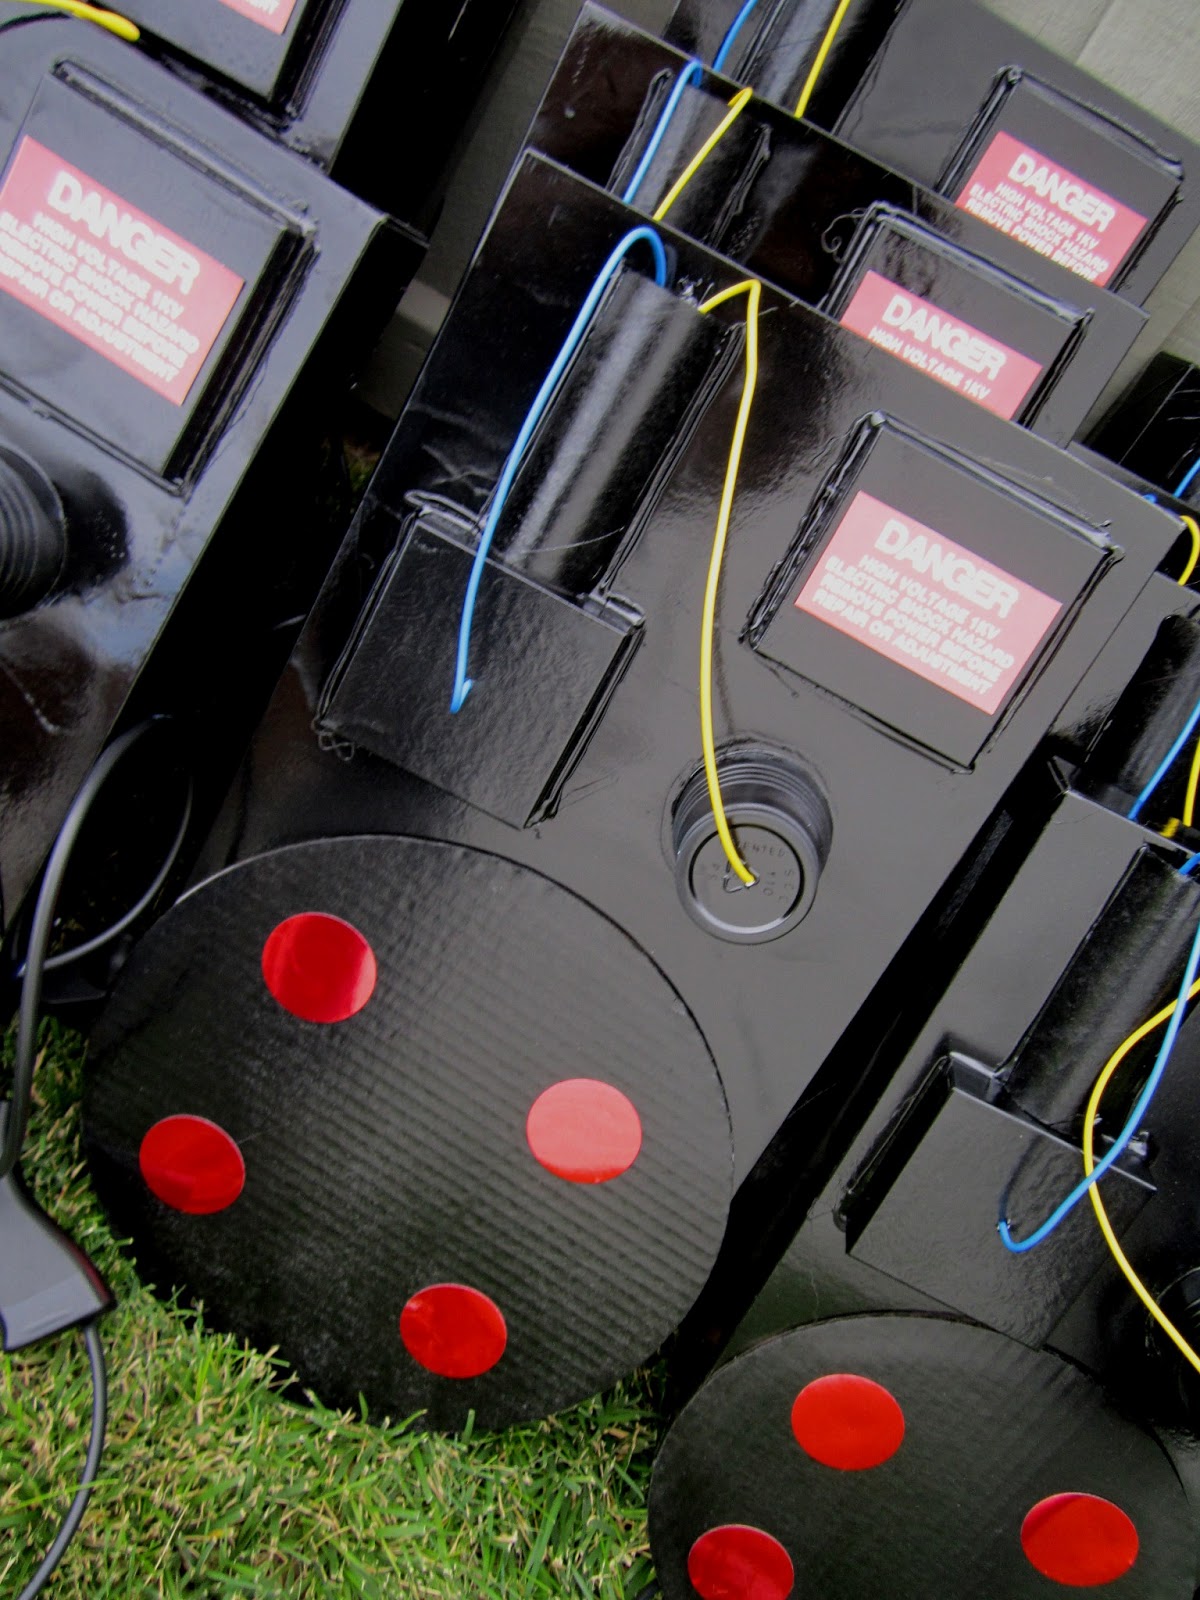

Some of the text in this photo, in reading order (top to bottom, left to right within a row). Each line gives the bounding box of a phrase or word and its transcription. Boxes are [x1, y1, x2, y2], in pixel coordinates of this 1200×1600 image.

[46, 169, 201, 297] DANGER
[964, 197, 1013, 234] REMOVE
[1010, 225, 1054, 258] POWER
[968, 183, 1110, 273] ELECTRIC SHOCK HAZARD
[993, 182, 1100, 250] HIGH VOLTAGE 1KV
[1008, 152, 1116, 233] DANGER
[33, 212, 77, 251] HIGH
[77, 240, 152, 300] VOLTAGE
[48, 288, 76, 317] OR
[73, 306, 180, 384] ADJUSTMENT
[62, 275, 124, 326] POWER
[121, 314, 189, 370] BEFORE
[77, 263, 137, 313] SHOCK
[133, 300, 200, 355] HAZARD
[881, 293, 1008, 382] DANGER
[867, 325, 992, 401] HIGH VOLTAGE 1KV
[824, 555, 1016, 670] ELECTRIC SHOCK HAZARD
[858, 554, 1002, 641] HIGH VOLTAGE 1KV
[873, 517, 1020, 619] DANGER
[811, 587, 994, 696] REPAIR OR ADJUSTMENT
[820, 572, 1003, 683] REMOVE POWER BEFORE
